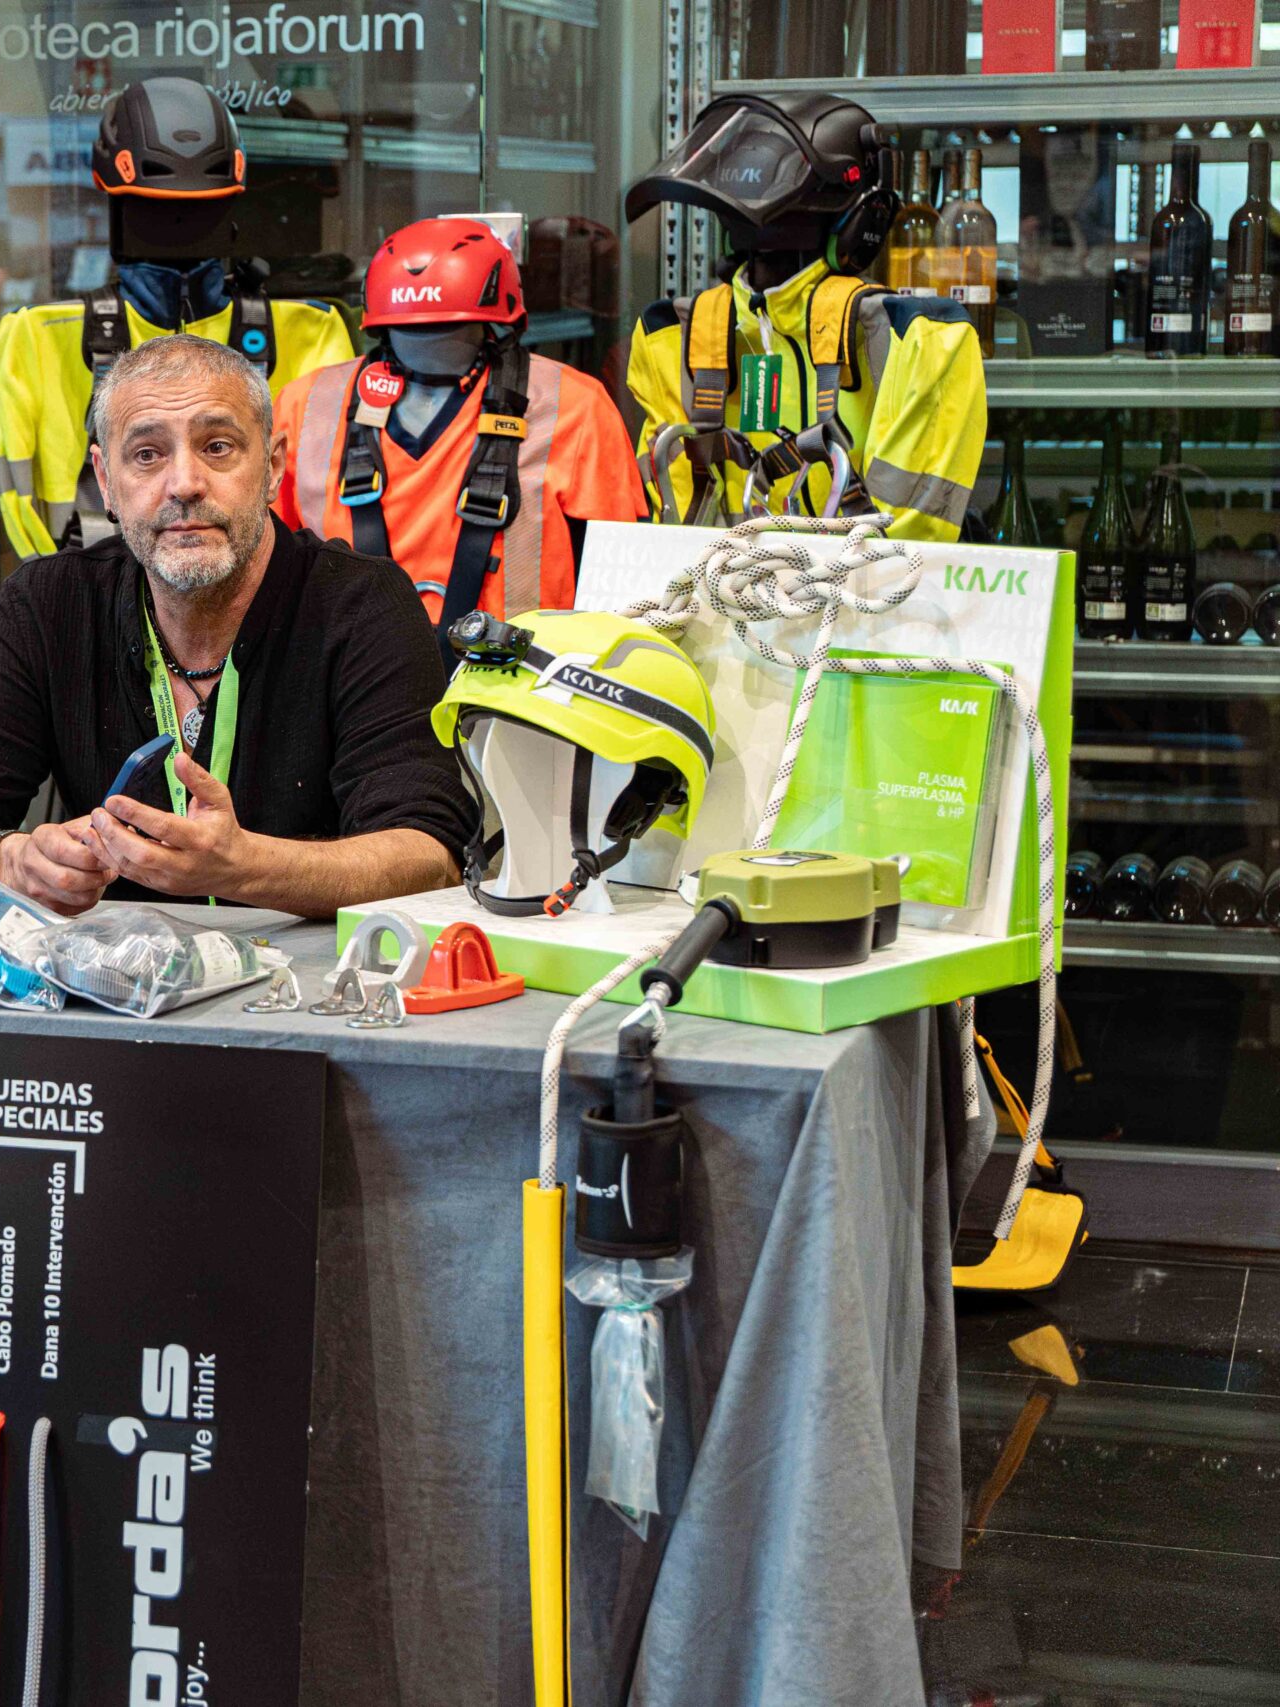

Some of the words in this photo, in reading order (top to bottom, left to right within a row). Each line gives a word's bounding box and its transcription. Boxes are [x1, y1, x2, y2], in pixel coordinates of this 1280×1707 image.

[155, 3, 426, 68] riojaforum
[721, 167, 762, 183] KASK
[391, 286, 442, 304] KASK
[494, 419, 520, 433] PETZL
[944, 564, 1029, 596] KASK
[563, 667, 625, 702] KASK
[939, 698, 979, 716] KASK
[937, 804, 945, 817] &
[949, 806, 965, 819] HP
[45, 1162, 67, 1291] Intervención
[44, 1295, 61, 1319] 10
[40, 1325, 59, 1379] Dana
[193, 1353, 216, 1420] think
[191, 1430, 213, 1472] We
